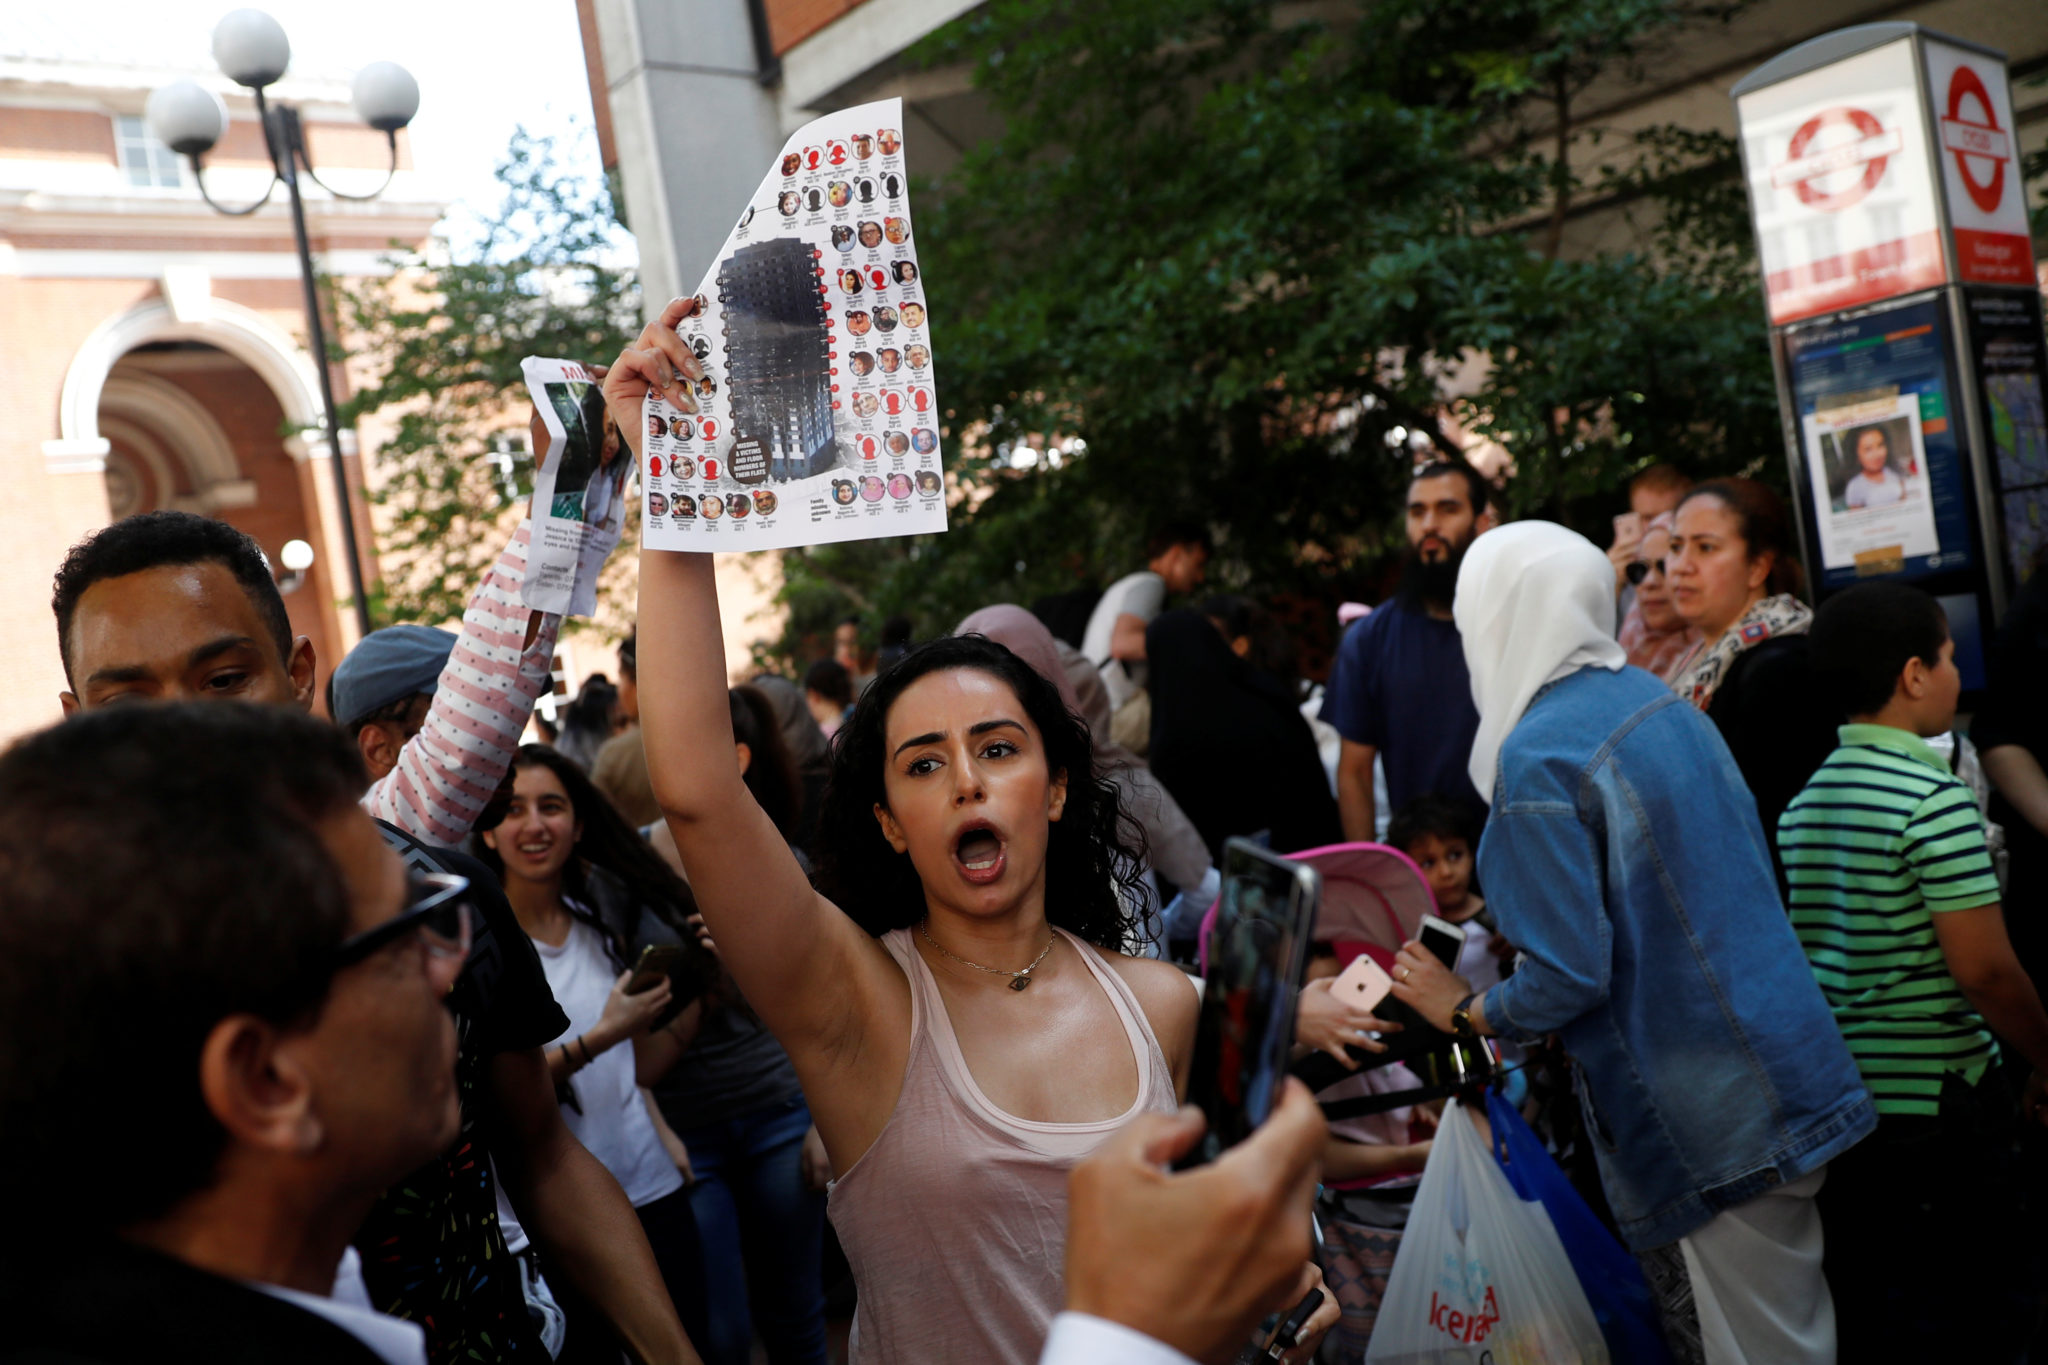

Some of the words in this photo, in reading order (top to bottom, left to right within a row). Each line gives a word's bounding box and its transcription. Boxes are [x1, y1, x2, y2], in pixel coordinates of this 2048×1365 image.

[737, 441, 759, 449] MISSING
[740, 448, 762, 456] VICTIMS
[734, 463, 759, 472] NUMBERS
[545, 525, 568, 536] Missing
[545, 533, 567, 542] Jessica
